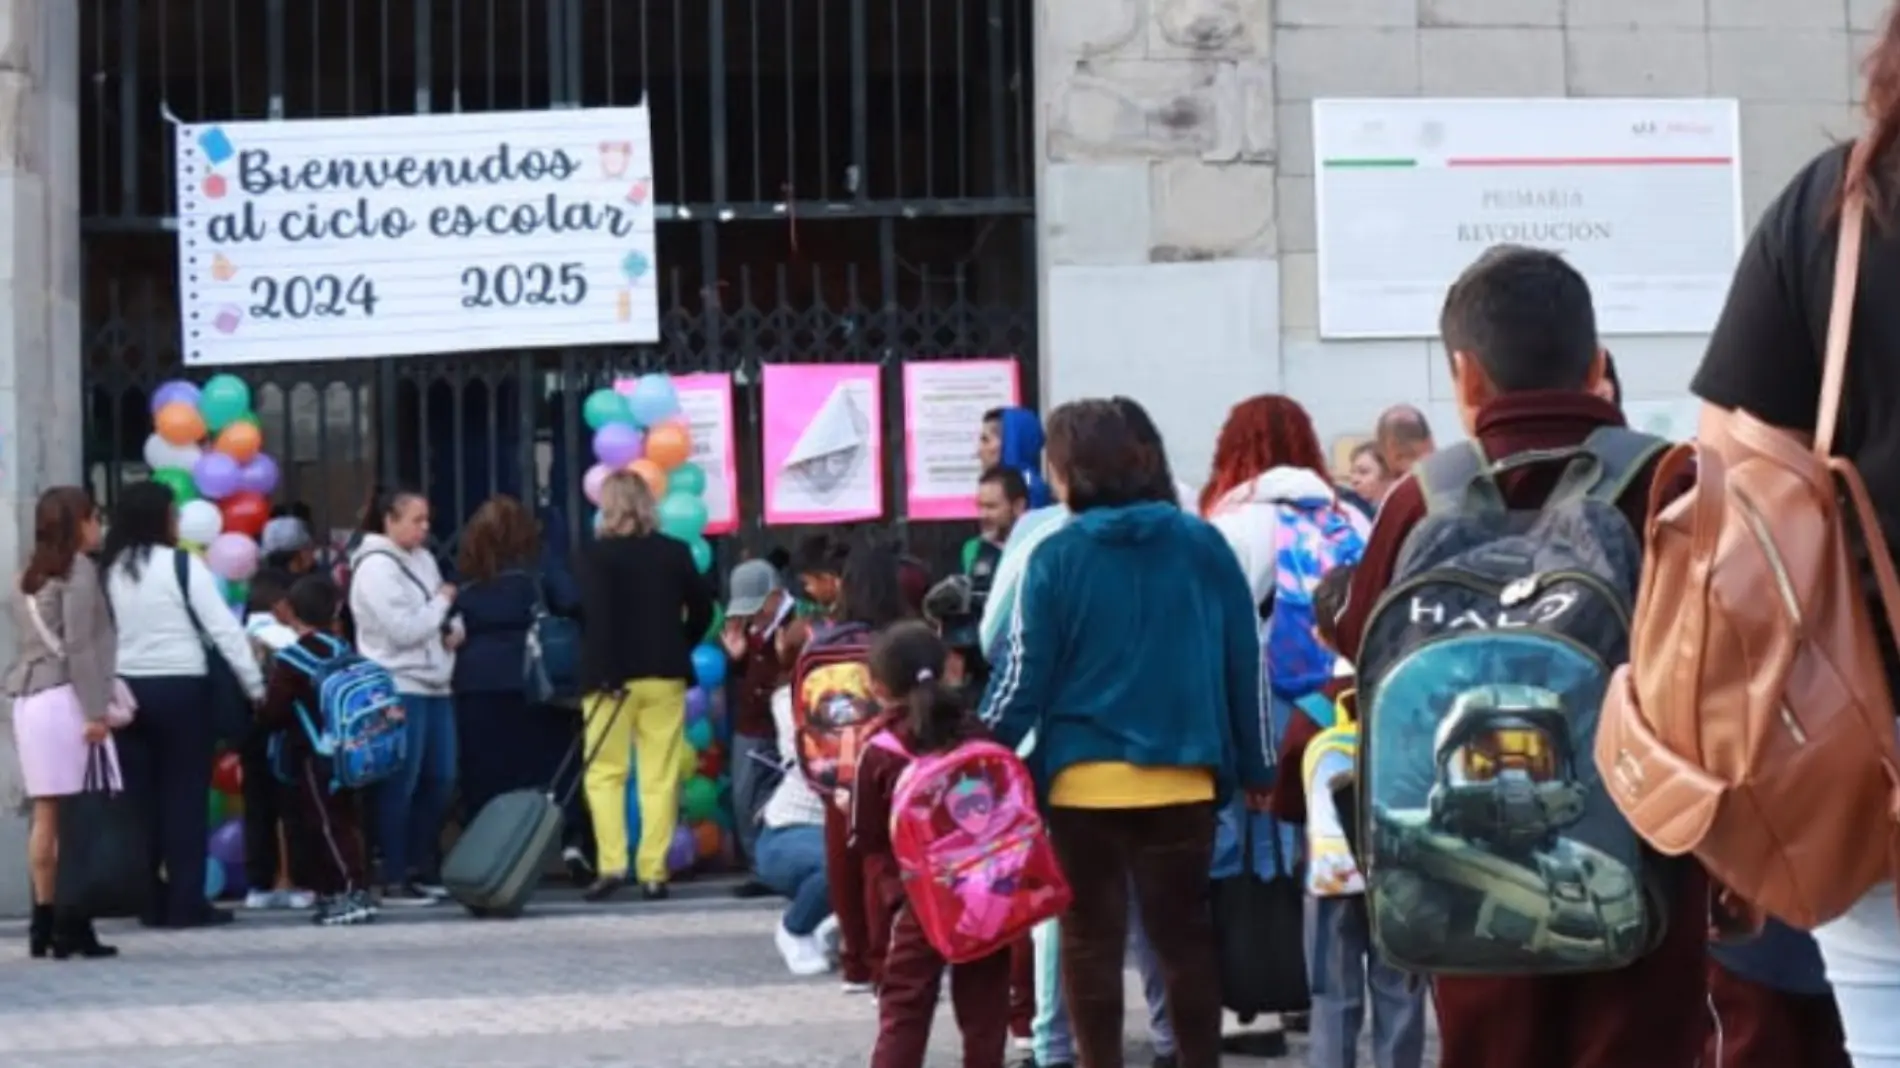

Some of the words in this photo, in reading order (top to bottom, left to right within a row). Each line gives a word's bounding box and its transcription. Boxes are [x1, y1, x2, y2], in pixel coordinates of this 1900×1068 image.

[238, 143, 579, 194] Bienvenidos
[207, 202, 267, 243] al
[278, 199, 415, 241] ciclo
[428, 194, 633, 237] escolar
[1482, 188, 1584, 209] PRIMARIA
[249, 274, 379, 317] 2024
[460, 263, 588, 307] 2025
[1410, 592, 1578, 629] HALO
